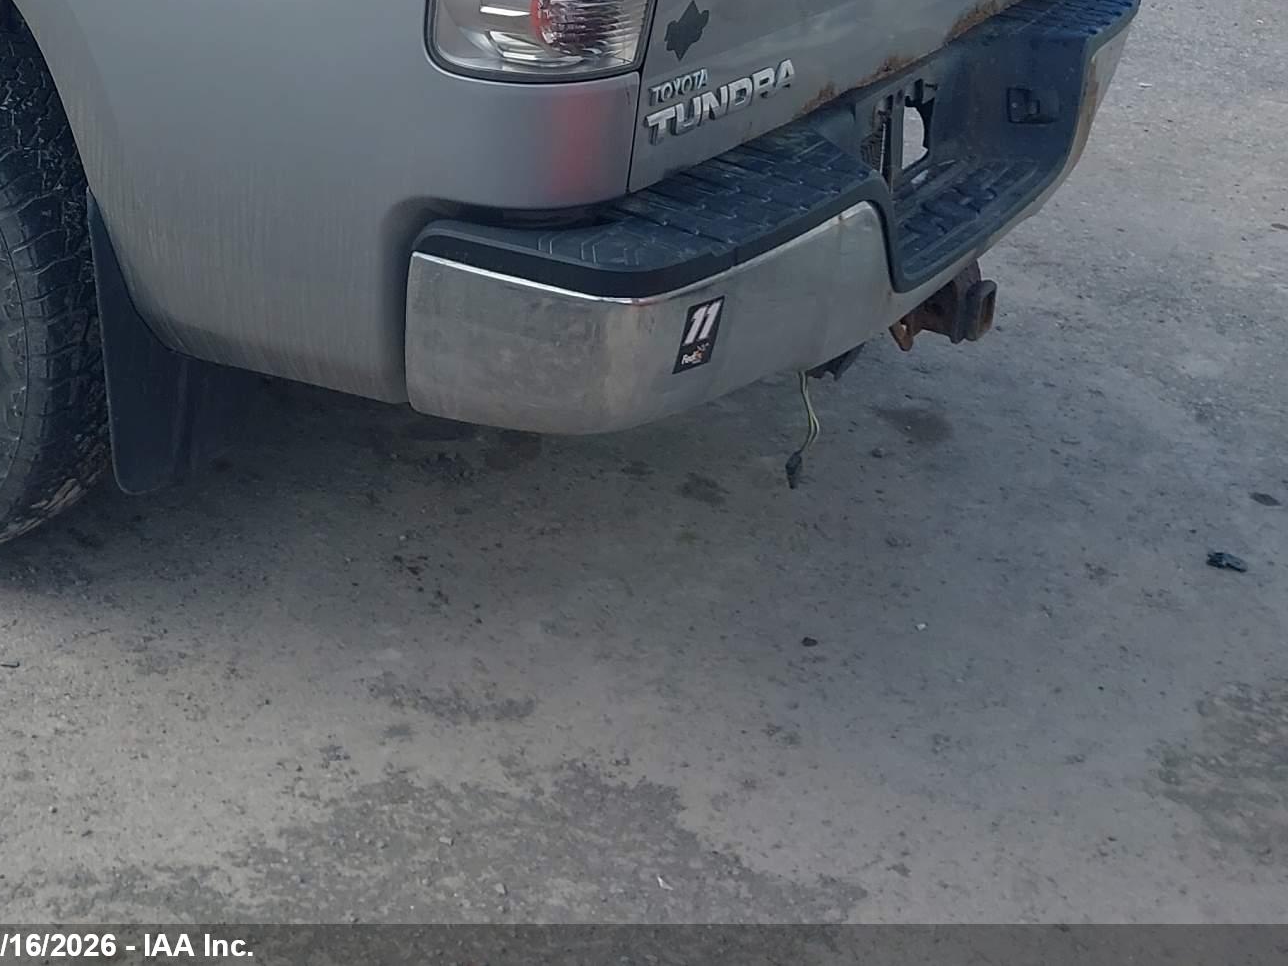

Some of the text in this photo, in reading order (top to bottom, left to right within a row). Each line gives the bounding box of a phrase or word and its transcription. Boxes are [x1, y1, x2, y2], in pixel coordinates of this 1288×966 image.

[644, 59, 795, 142] TUNDRA
[650, 68, 708, 104] TOYOTA
[683, 300, 722, 345] 11
